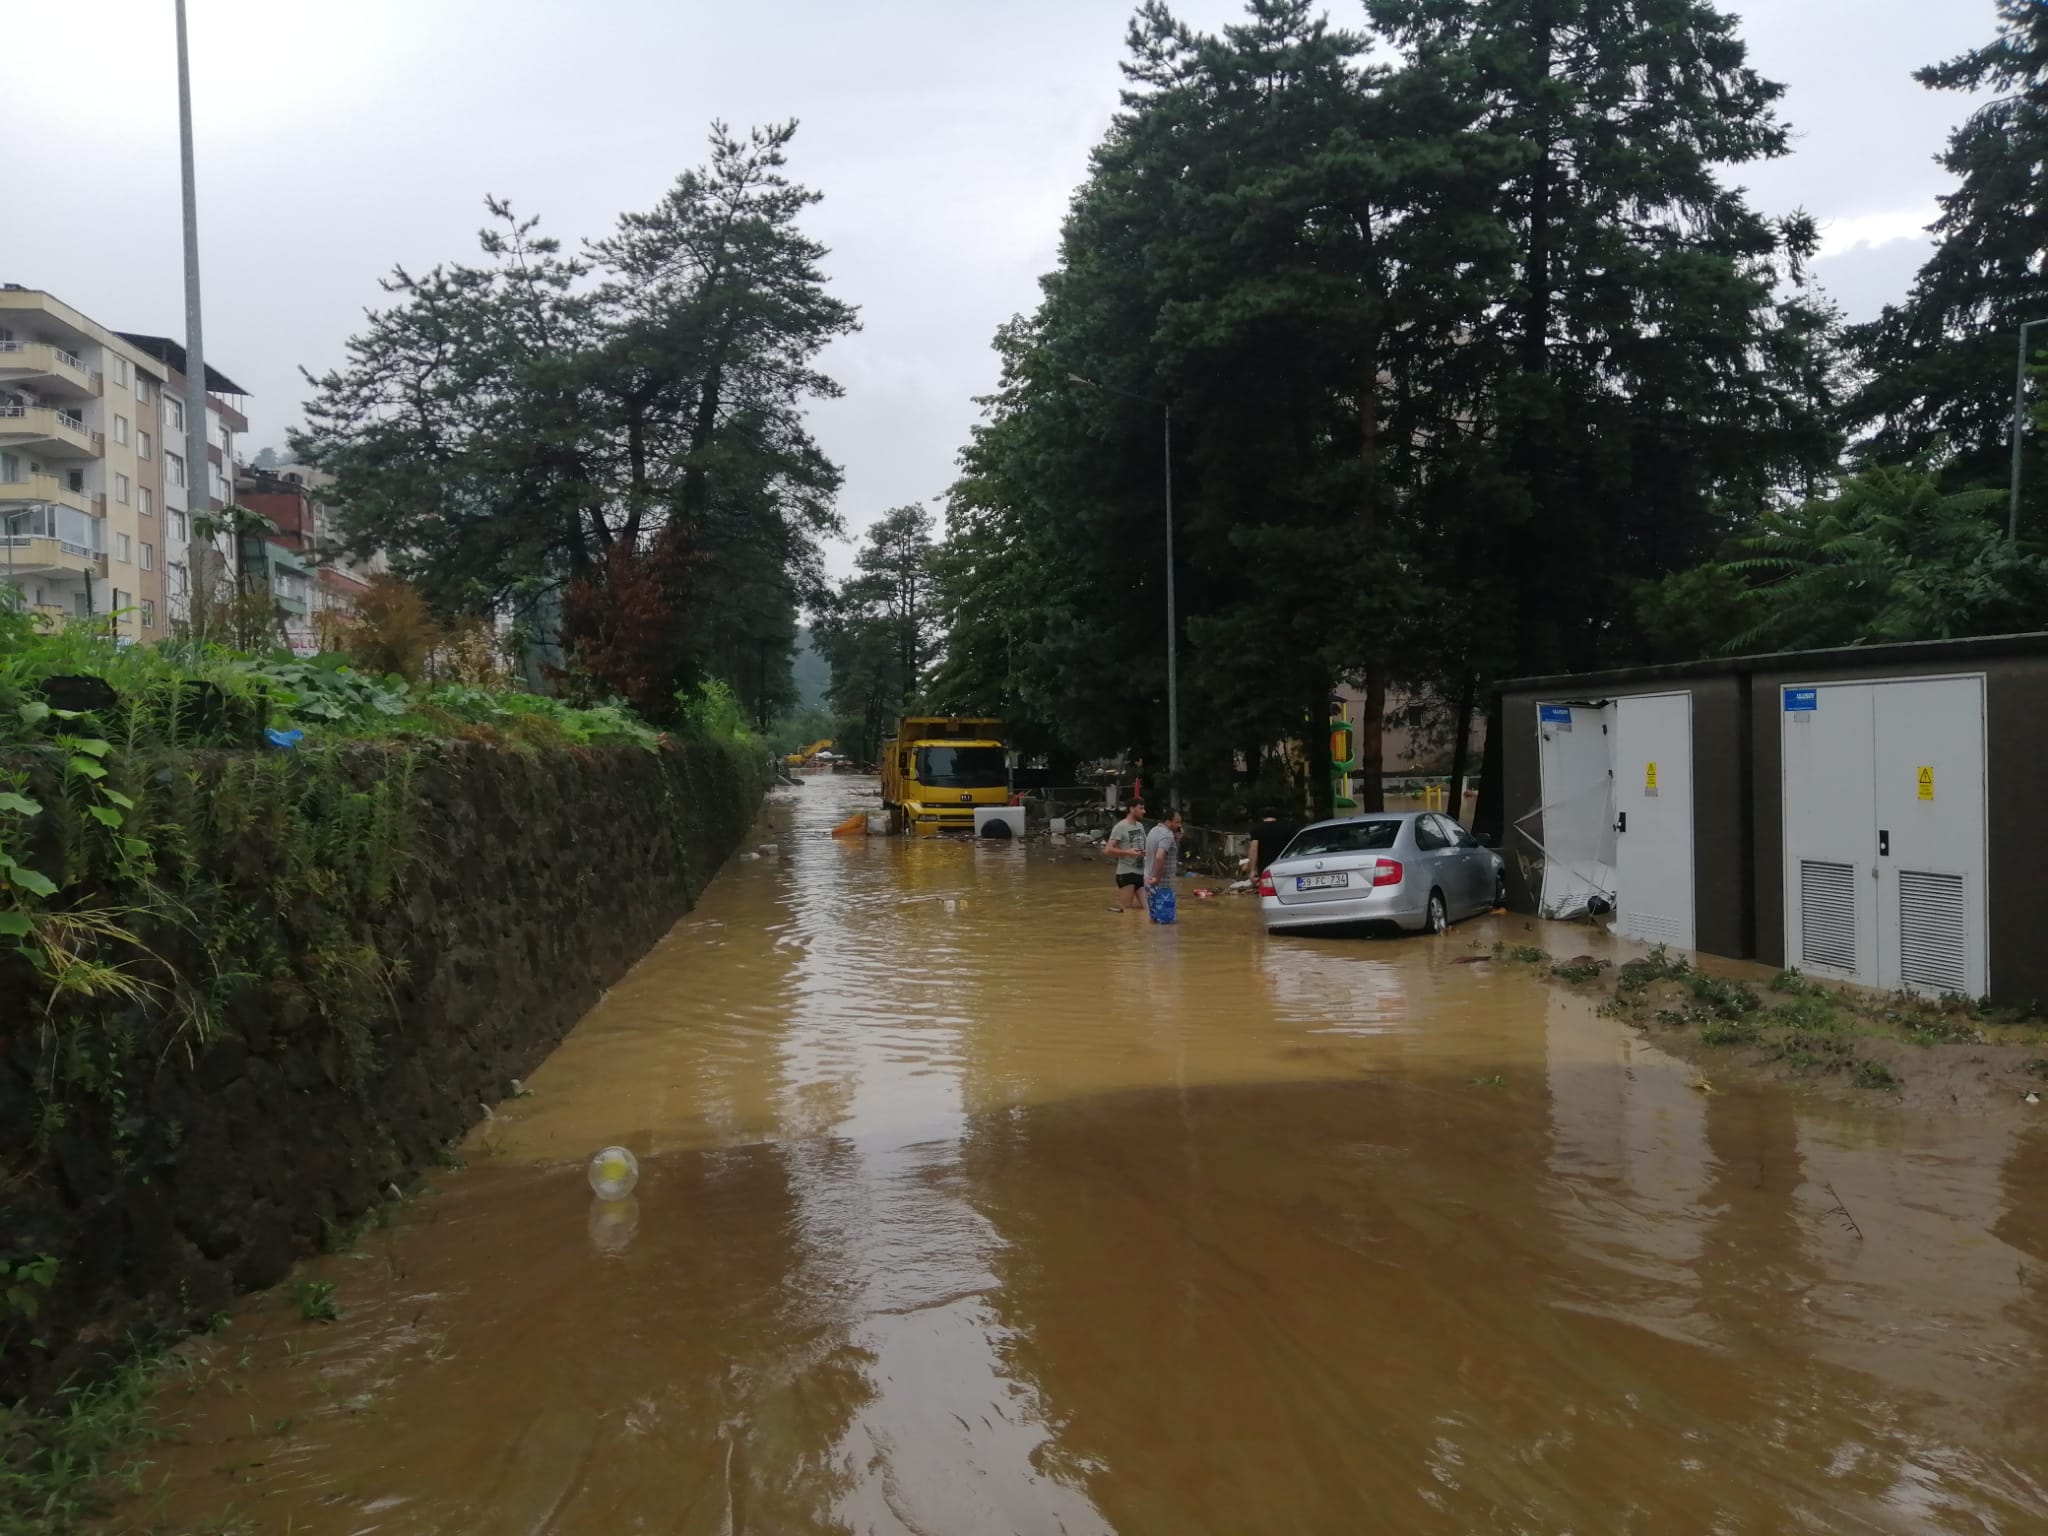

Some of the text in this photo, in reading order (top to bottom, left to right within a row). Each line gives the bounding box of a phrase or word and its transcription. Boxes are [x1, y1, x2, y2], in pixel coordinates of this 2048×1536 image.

[1301, 875, 1346, 887] 59 FC 734
